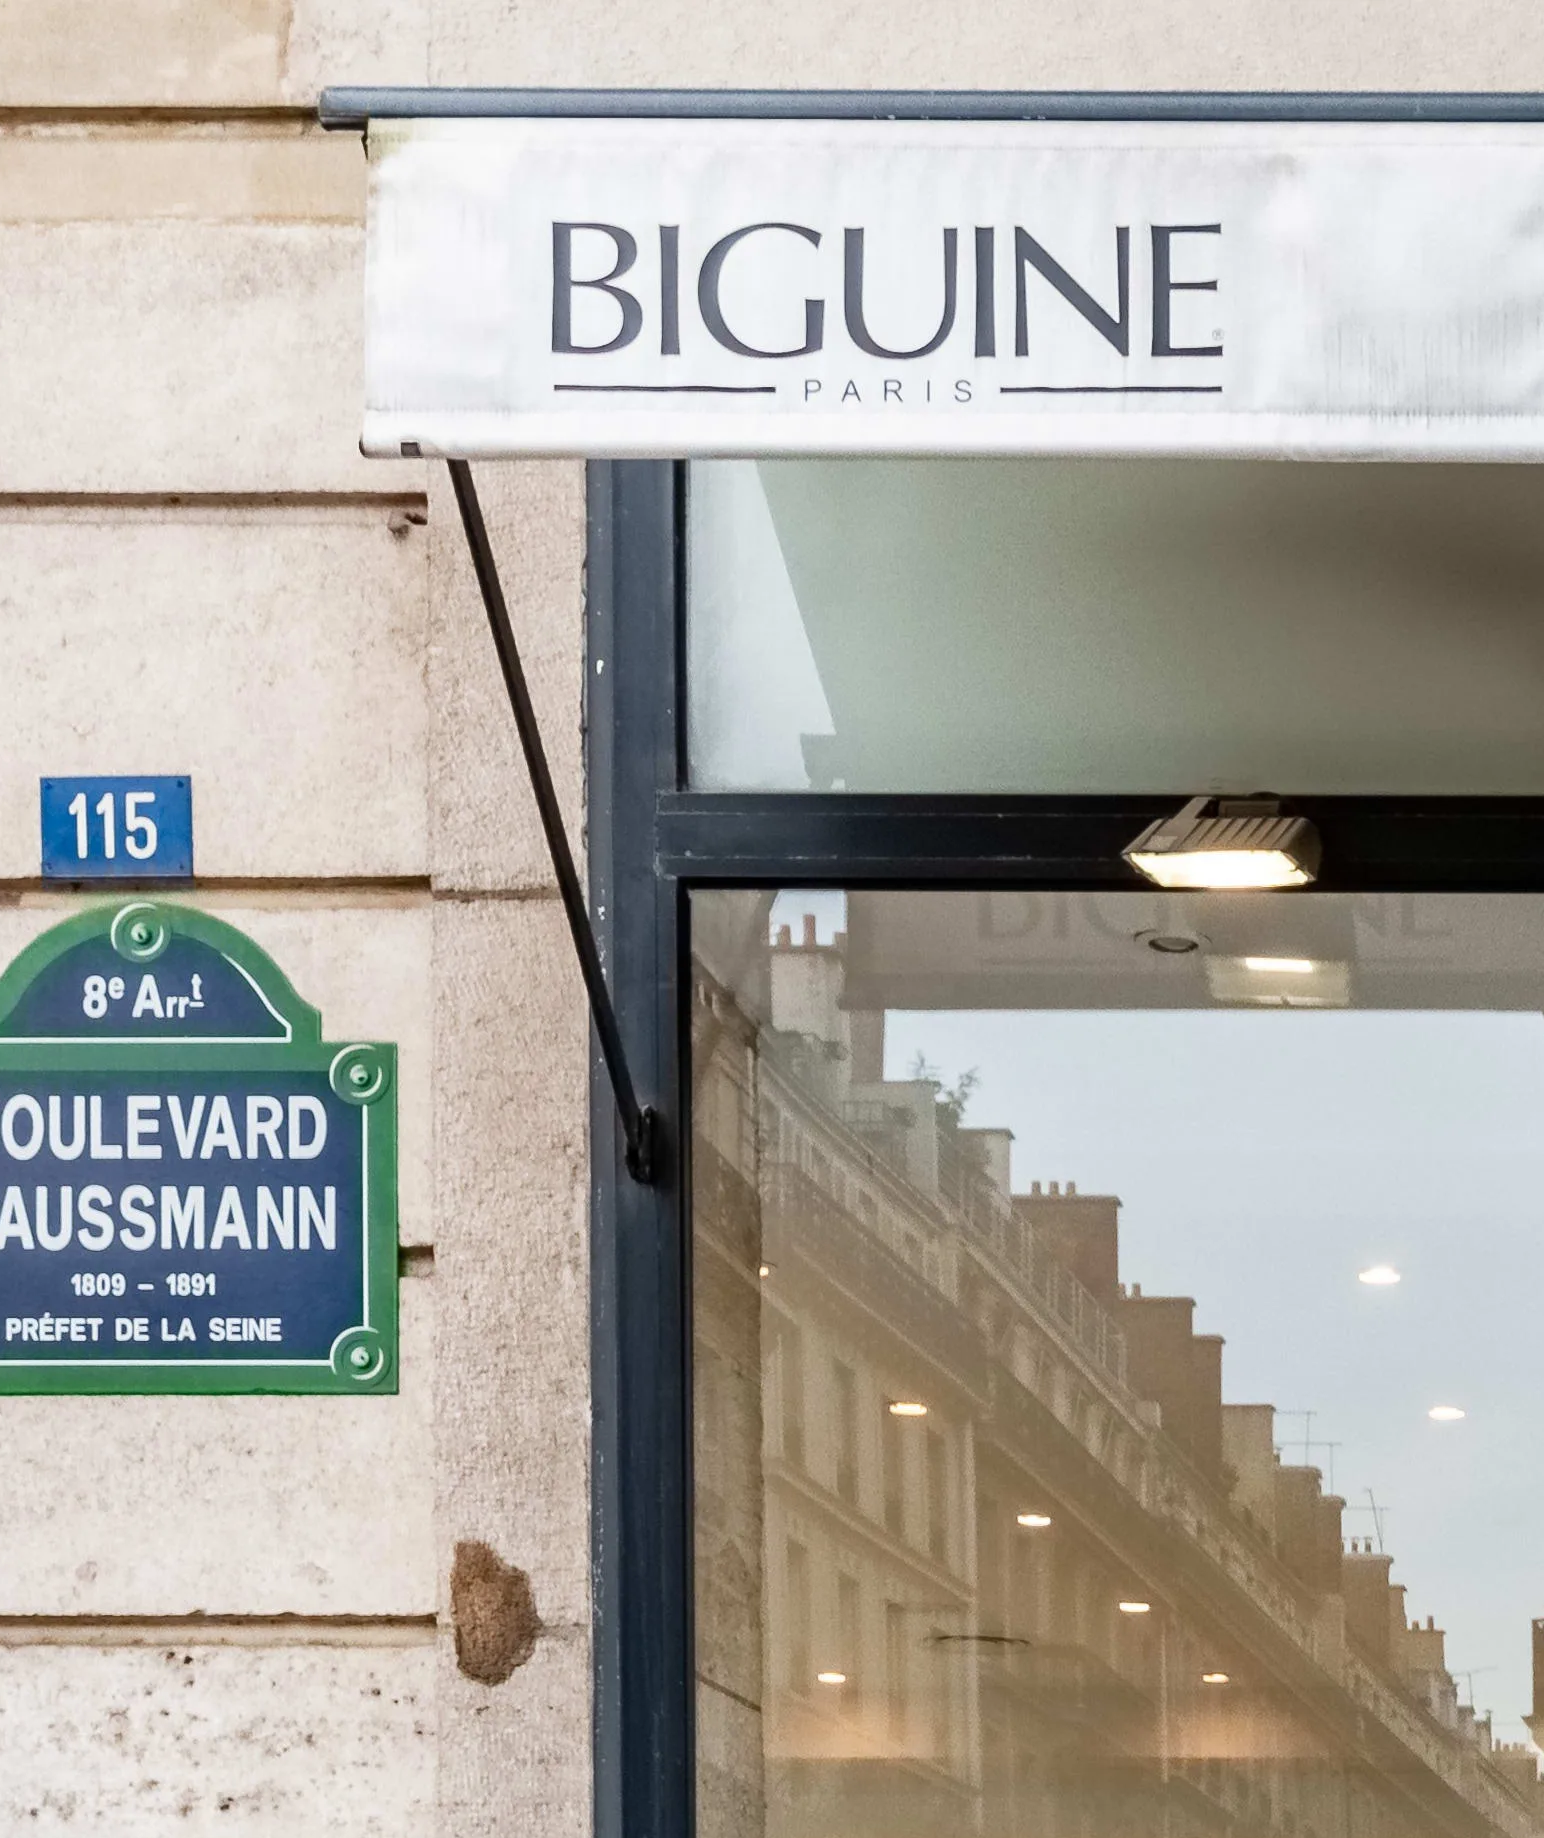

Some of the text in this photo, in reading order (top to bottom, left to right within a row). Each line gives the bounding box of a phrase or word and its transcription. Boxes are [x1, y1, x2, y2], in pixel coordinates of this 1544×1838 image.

[551, 220, 1224, 359] BIGUINE
[803, 378, 974, 404] PARIS
[67, 790, 159, 860] 115
[70, 1273, 126, 1298] 1809
[165, 1272, 217, 1298] 1891
[4, 1311, 282, 1343] PRÉFET DE LA SEINE
